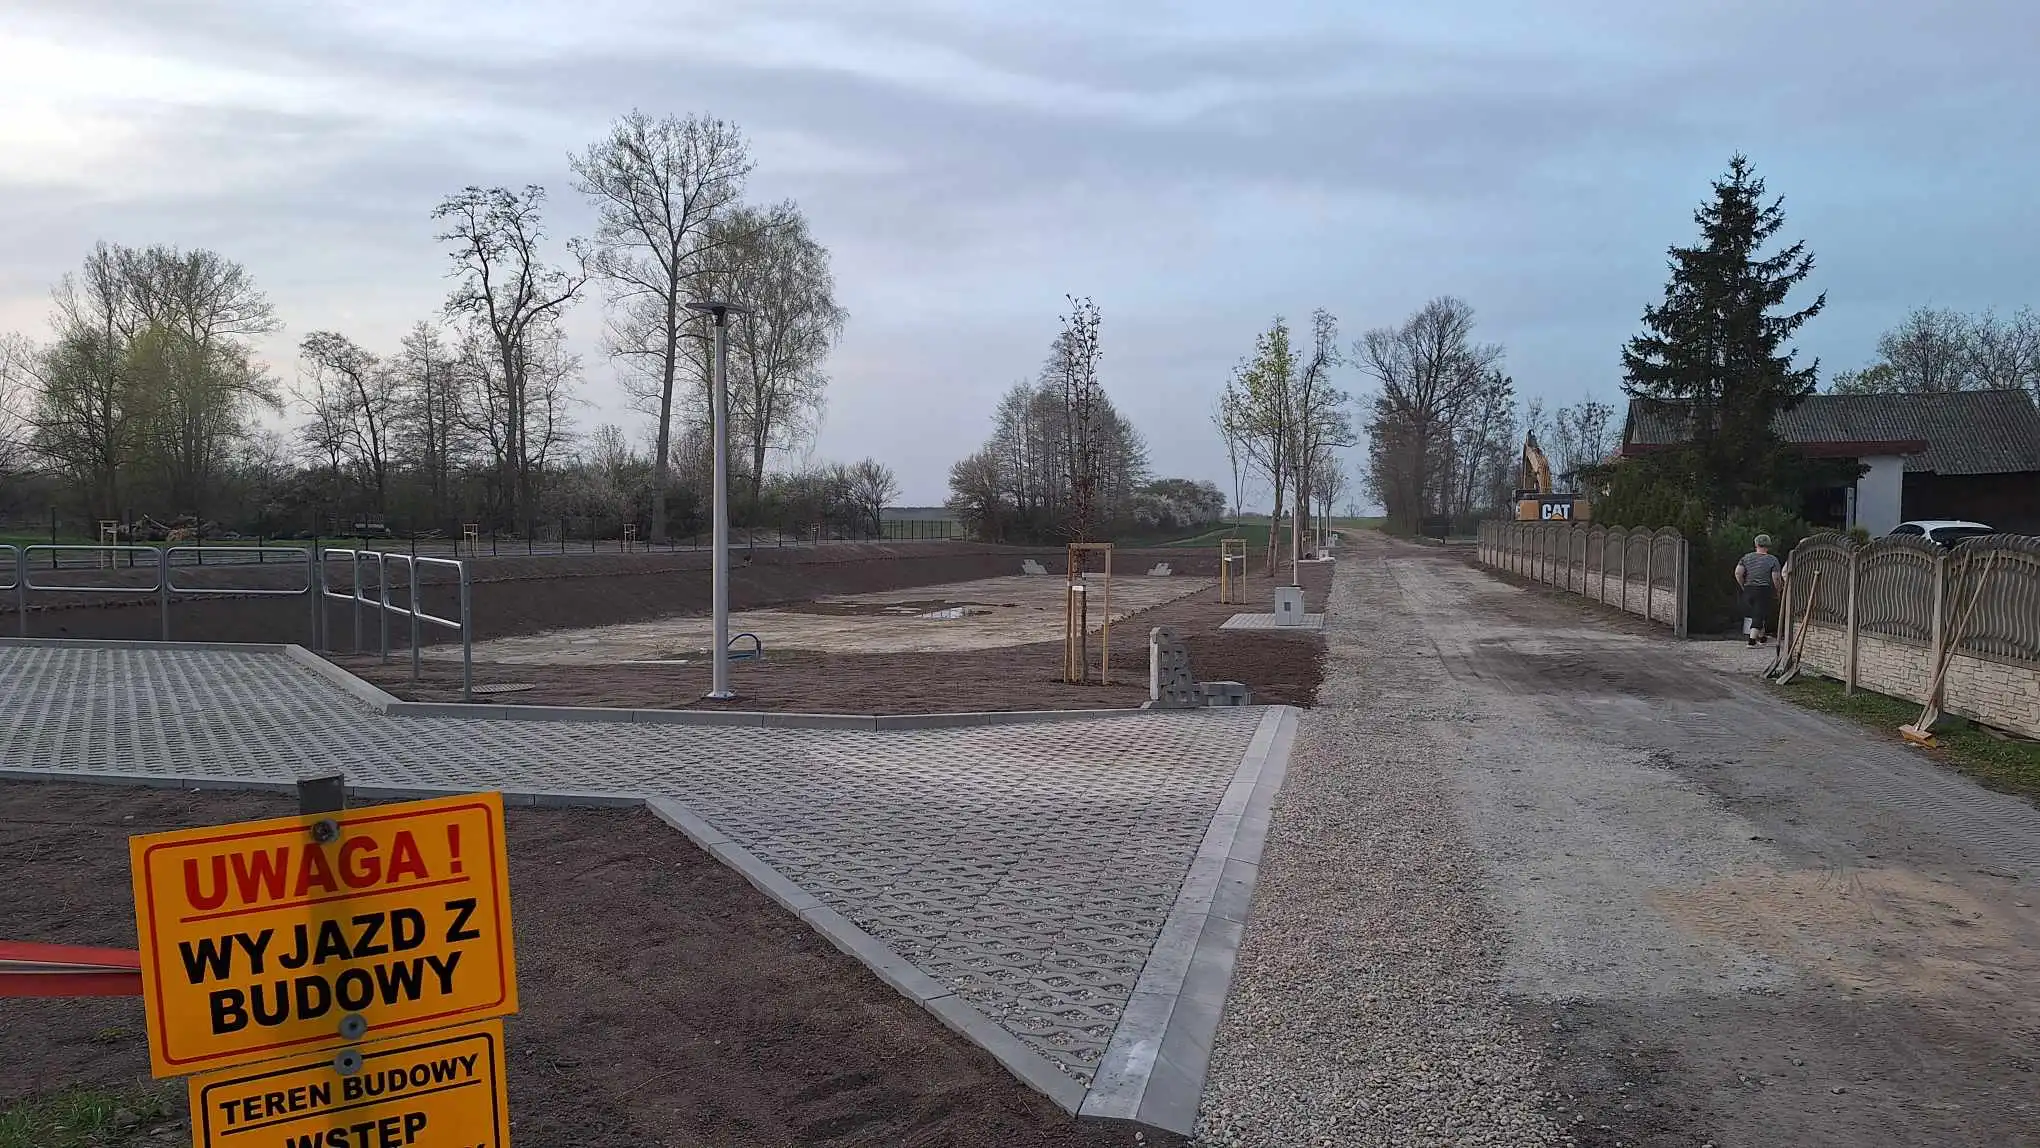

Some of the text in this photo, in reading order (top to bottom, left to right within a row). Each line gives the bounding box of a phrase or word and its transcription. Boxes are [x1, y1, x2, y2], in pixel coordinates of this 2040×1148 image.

[1542, 503, 1571, 520] CAT
[183, 824, 464, 911] UWAGA !
[178, 897, 480, 985] WYJAZD Z
[210, 951, 462, 1035] BUDOWY
[219, 1053, 478, 1125] TEREN BUDOWY
